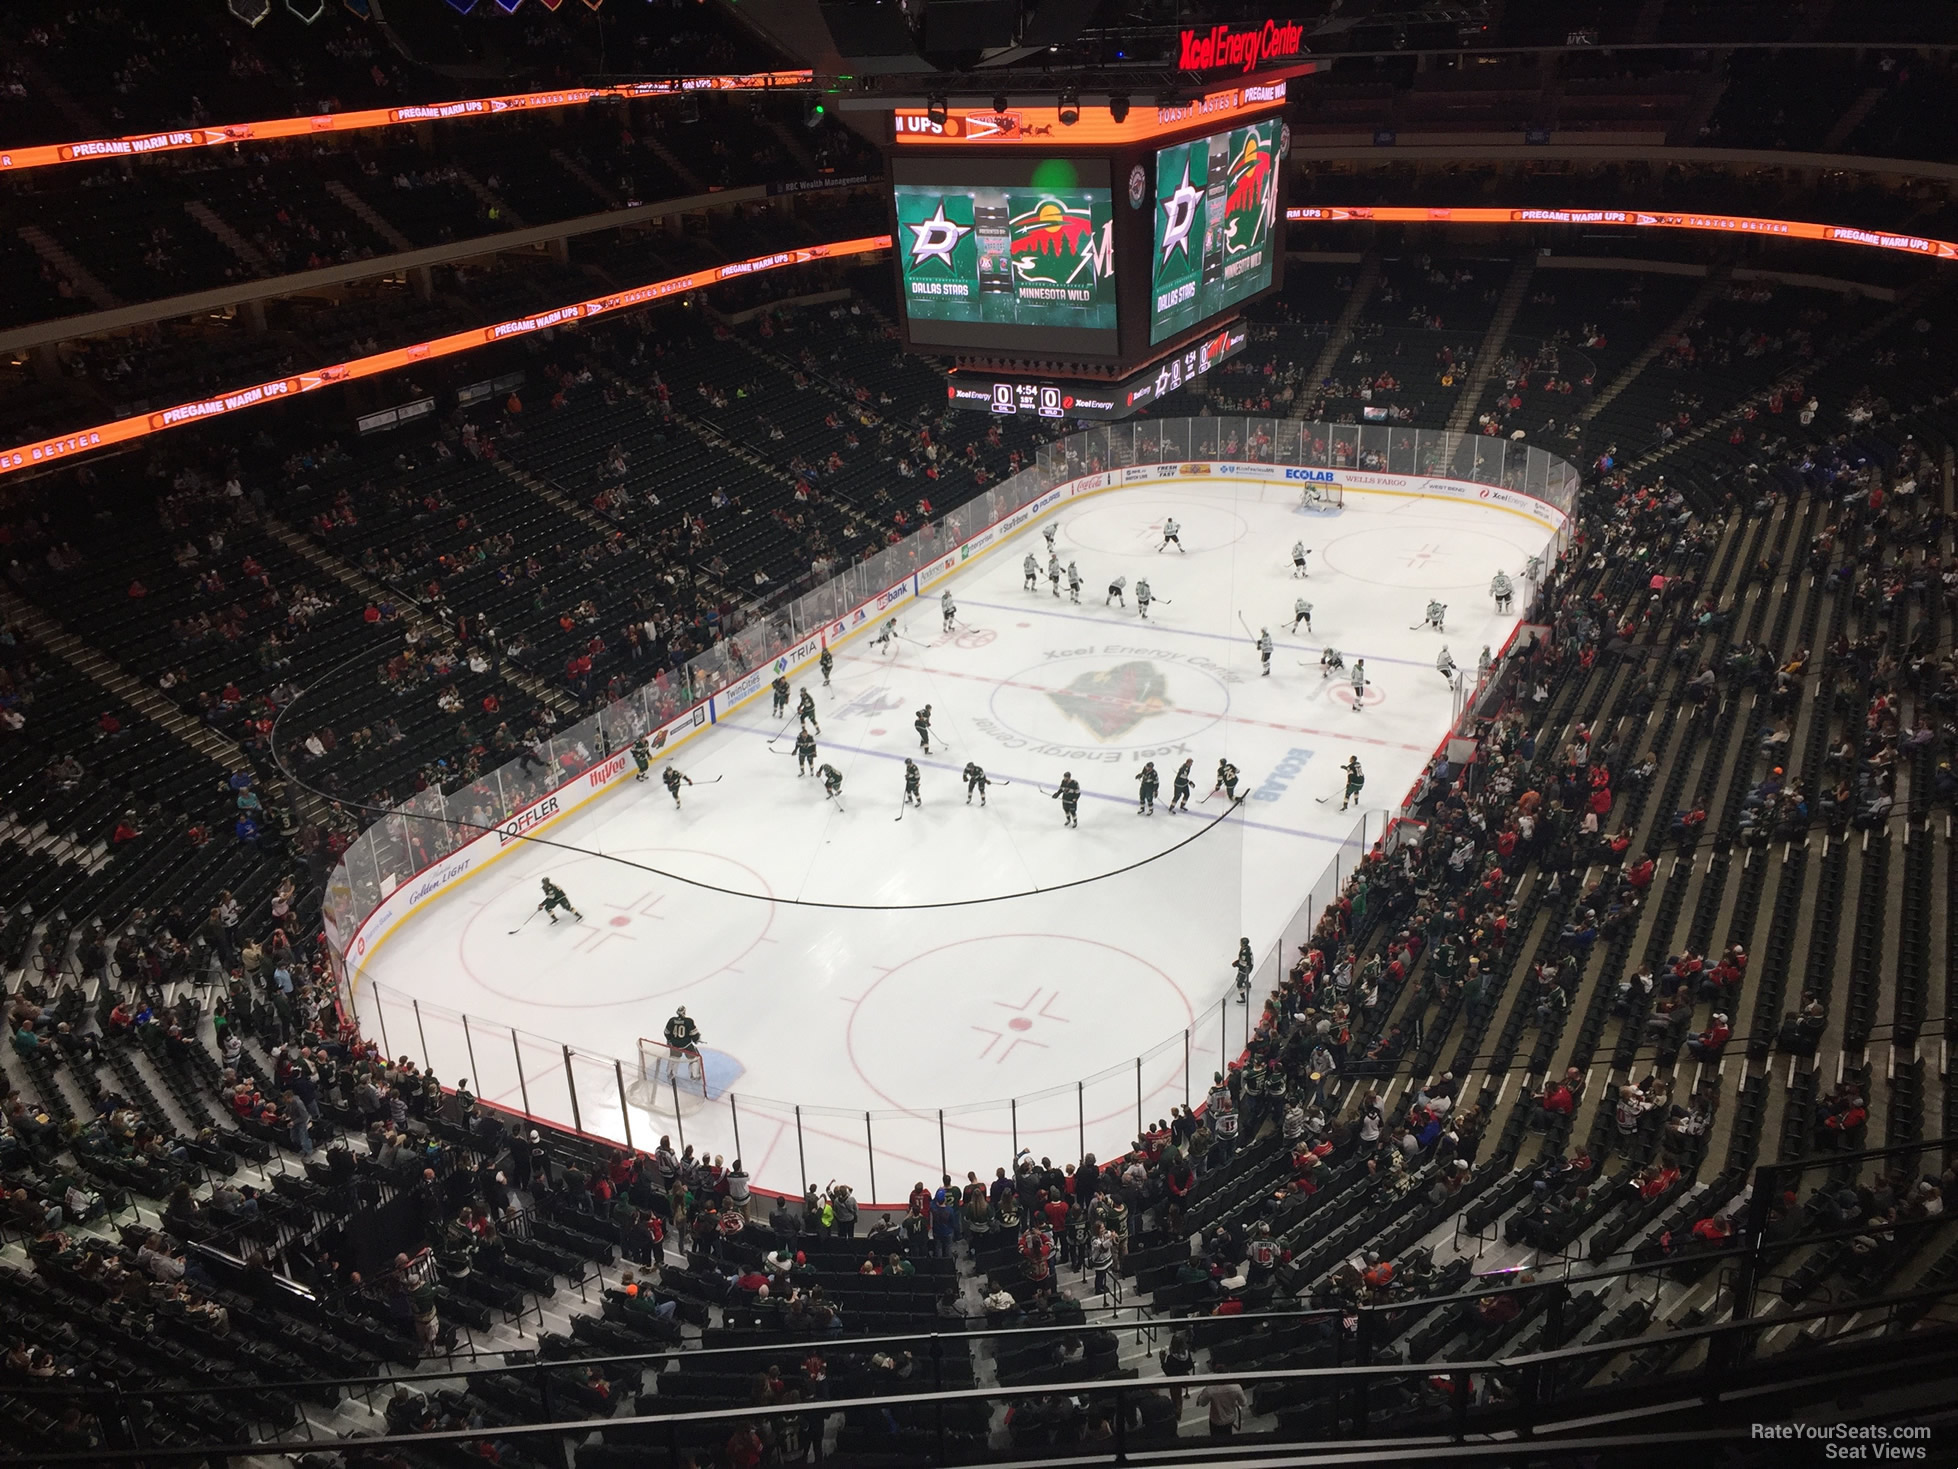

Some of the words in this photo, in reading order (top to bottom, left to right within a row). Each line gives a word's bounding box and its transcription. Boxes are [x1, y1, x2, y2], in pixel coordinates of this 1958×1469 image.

[1179, 27, 1216, 70] Xcel
[1215, 25, 1263, 73] Energy
[1261, 18, 1304, 59] Center
[530, 94, 564, 106] TASTES
[1244, 86, 1275, 103] PREGAME
[398, 105, 440, 120] PREGAME
[440, 103, 465, 118] WARM
[467, 101, 483, 113] UPS
[908, 117, 943, 134] UPS
[72, 141, 132, 158] PREGAME
[132, 135, 169, 153] WARM
[171, 132, 193, 146] UPS
[799, 179, 824, 190] Wealth
[824, 174, 868, 188] Management
[1302, 209, 1321, 218] UPS
[1522, 210, 1570, 222] PREGAME
[1571, 211, 1600, 222] WARM
[1601, 212, 1626, 223] UPS
[1689, 217, 1736, 229] TASTES
[1741, 221, 1789, 233] BETTER
[1833, 228, 1880, 245] PREGAME
[1880, 236, 1909, 248] WARM
[1909, 239, 1929, 251] UPS
[721, 262, 752, 277] PREGAME
[752, 256, 773, 271] WARM
[774, 253, 789, 265] UPS
[624, 287, 658, 303] TASTES
[661, 278, 694, 294] BETTER
[912, 282, 942, 295] DALLAS
[943, 283, 969, 297] STARS
[1019, 287, 1067, 300] MINNESOTA
[1067, 289, 1090, 302] WILD
[494, 319, 536, 338] PREGAME
[535, 311, 562, 328] WARM
[561, 306, 578, 319] UPS
[998, 386, 1009, 404] 0
[1016, 384, 1038, 396] 4:54
[162, 399, 225, 425] PREGAME
[224, 388, 263, 412] WARM
[263, 381, 288, 398] UPS
[1044, 391, 1057, 407] 0
[32, 432, 101, 461] BETTER
[1285, 468, 1335, 483] ECOLAB
[1345, 475, 1376, 485] WELLS
[1376, 477, 1408, 488] FARGO
[1429, 484, 1447, 492] WEST
[789, 640, 817, 665] TRIA
[1043, 645, 1095, 661] Xcel
[1103, 644, 1185, 661] Energy
[1186, 656, 1244, 685] Center
[499, 796, 560, 842] LOFFLER
[409, 875, 441, 906] Golden
[442, 858, 472, 884] LIGHT
[672, 1024, 686, 1039] 40
